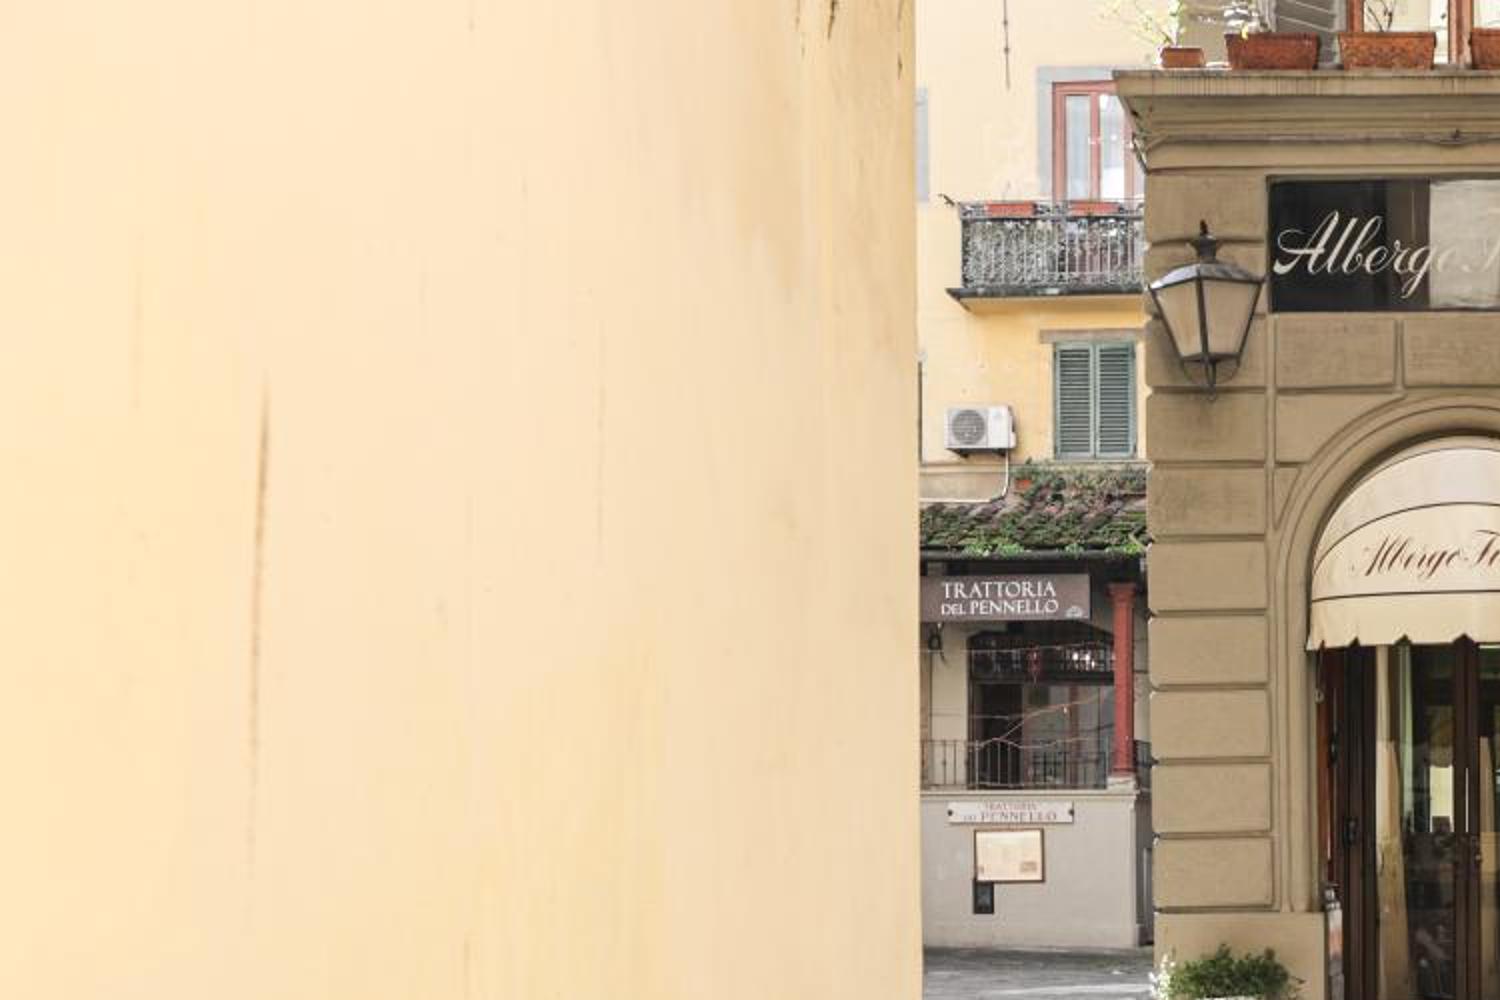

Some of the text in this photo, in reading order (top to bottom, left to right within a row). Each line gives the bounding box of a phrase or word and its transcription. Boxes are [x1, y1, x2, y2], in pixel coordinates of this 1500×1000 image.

[1272, 209, 1458, 300] Albergo
[1353, 533, 1462, 578] Albergo
[941, 580, 1057, 599] TRATTORIA
[941, 599, 1060, 615] DEL PENNELLO
